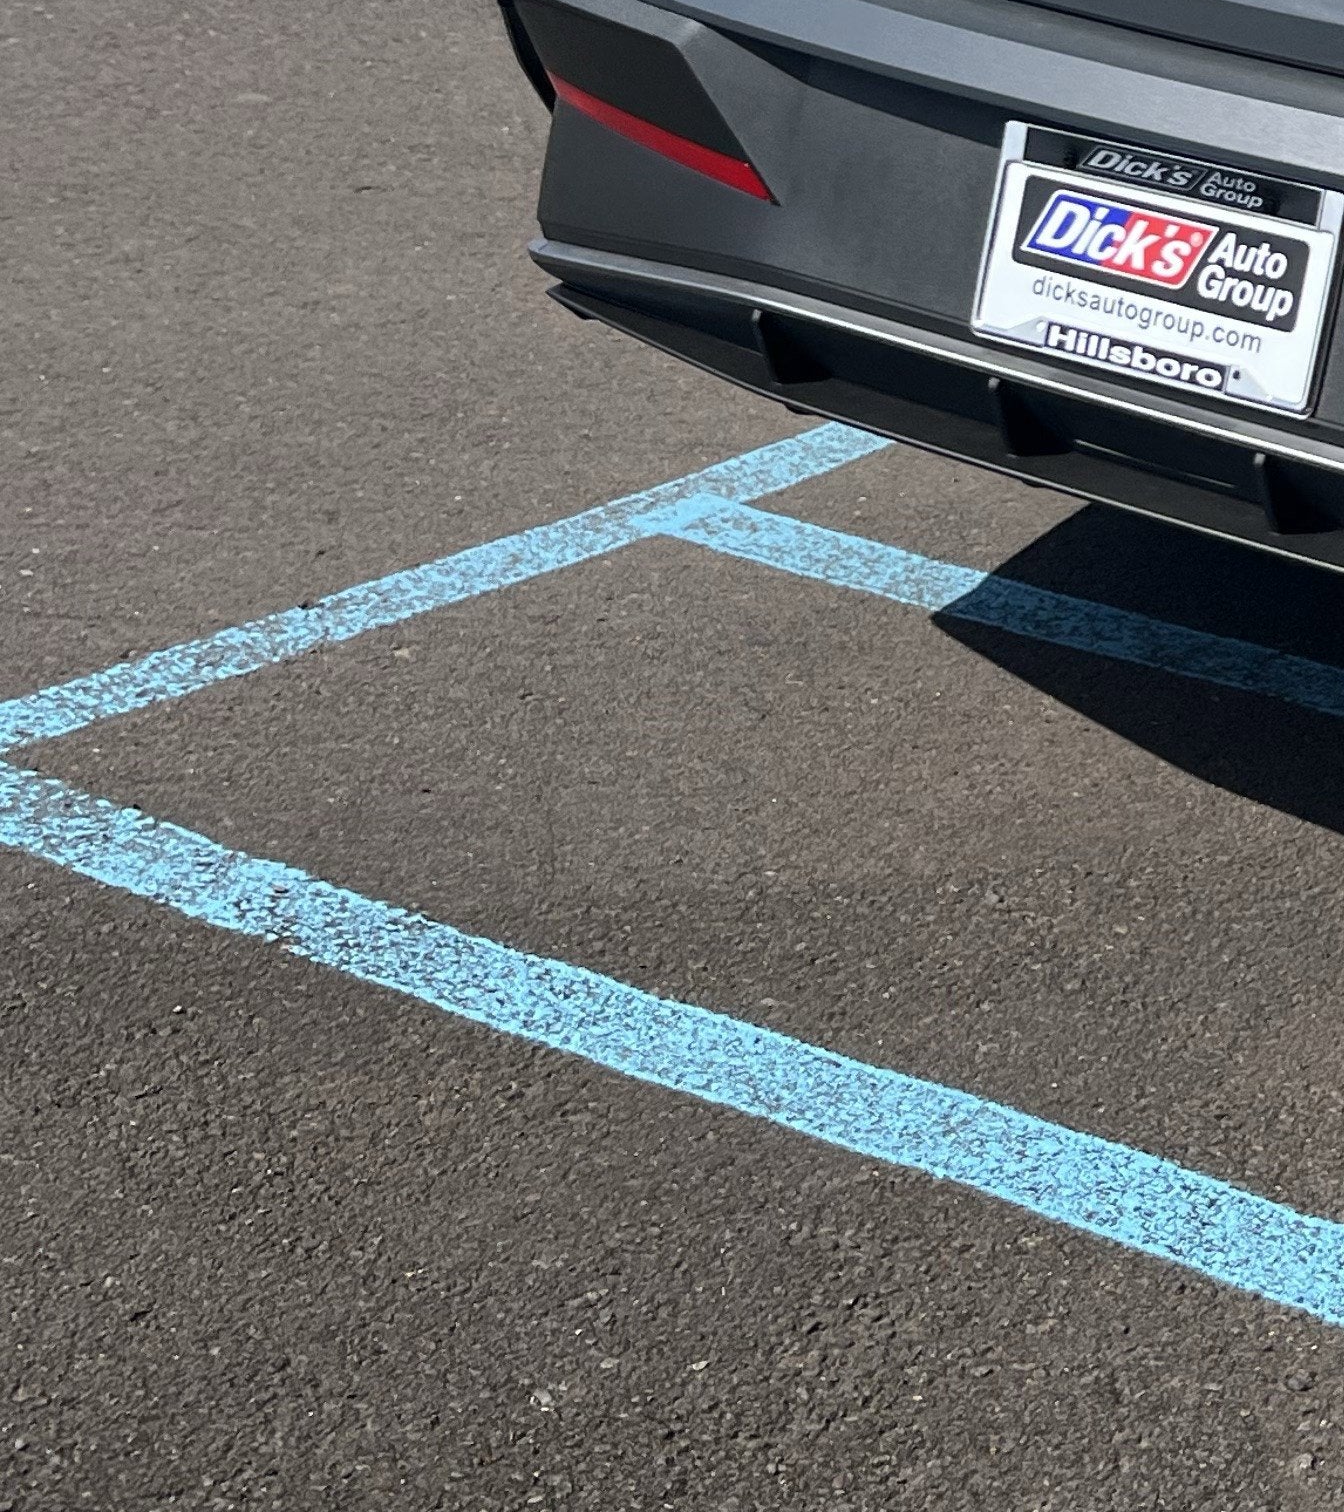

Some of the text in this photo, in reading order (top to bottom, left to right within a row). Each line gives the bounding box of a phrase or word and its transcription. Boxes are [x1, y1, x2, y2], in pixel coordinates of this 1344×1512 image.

[1088, 149, 1256, 192] Dick's Auto
[1200, 184, 1264, 209] Group
[1035, 200, 1288, 279] Dick's Auto
[1032, 275, 1262, 354] dicksautogroup.com
[1197, 264, 1294, 322] Group
[1048, 324, 1222, 388] Hillsboro
